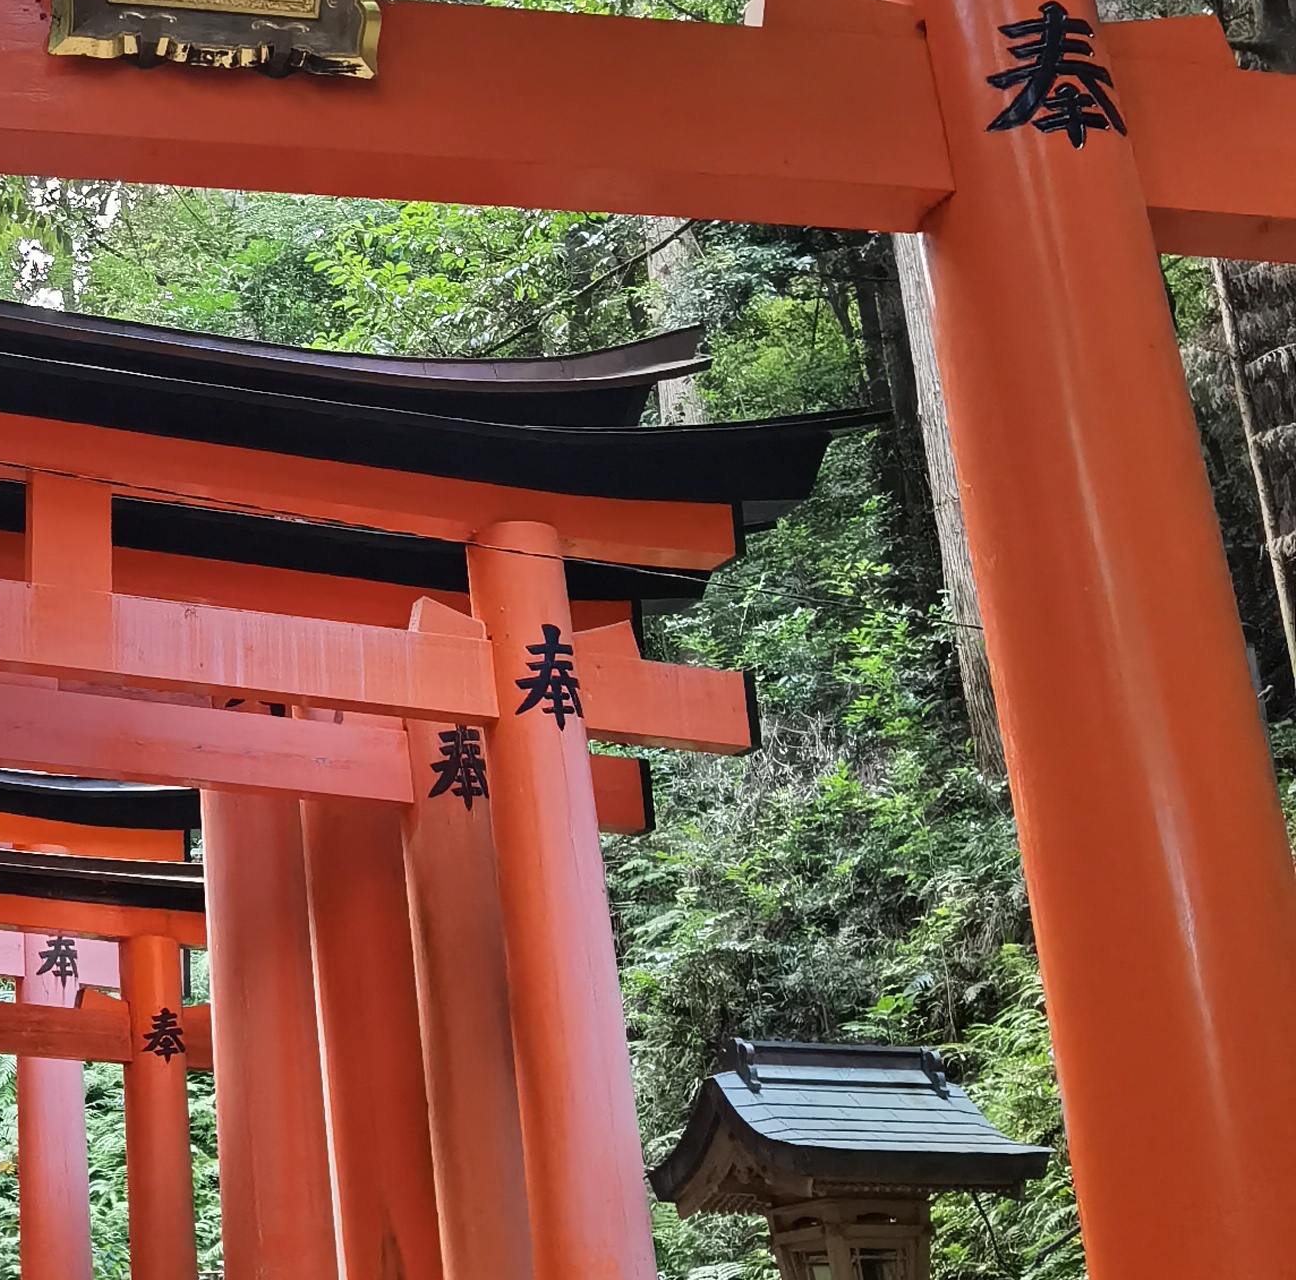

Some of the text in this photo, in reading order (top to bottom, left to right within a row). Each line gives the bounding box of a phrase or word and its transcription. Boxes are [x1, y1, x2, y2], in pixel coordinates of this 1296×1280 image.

[984, 0, 1129, 151] 奉
[514, 623, 584, 732] 奉
[427, 723, 490, 812] 奉
[35, 935, 79, 990] 奉
[141, 1007, 186, 1065] 奉
